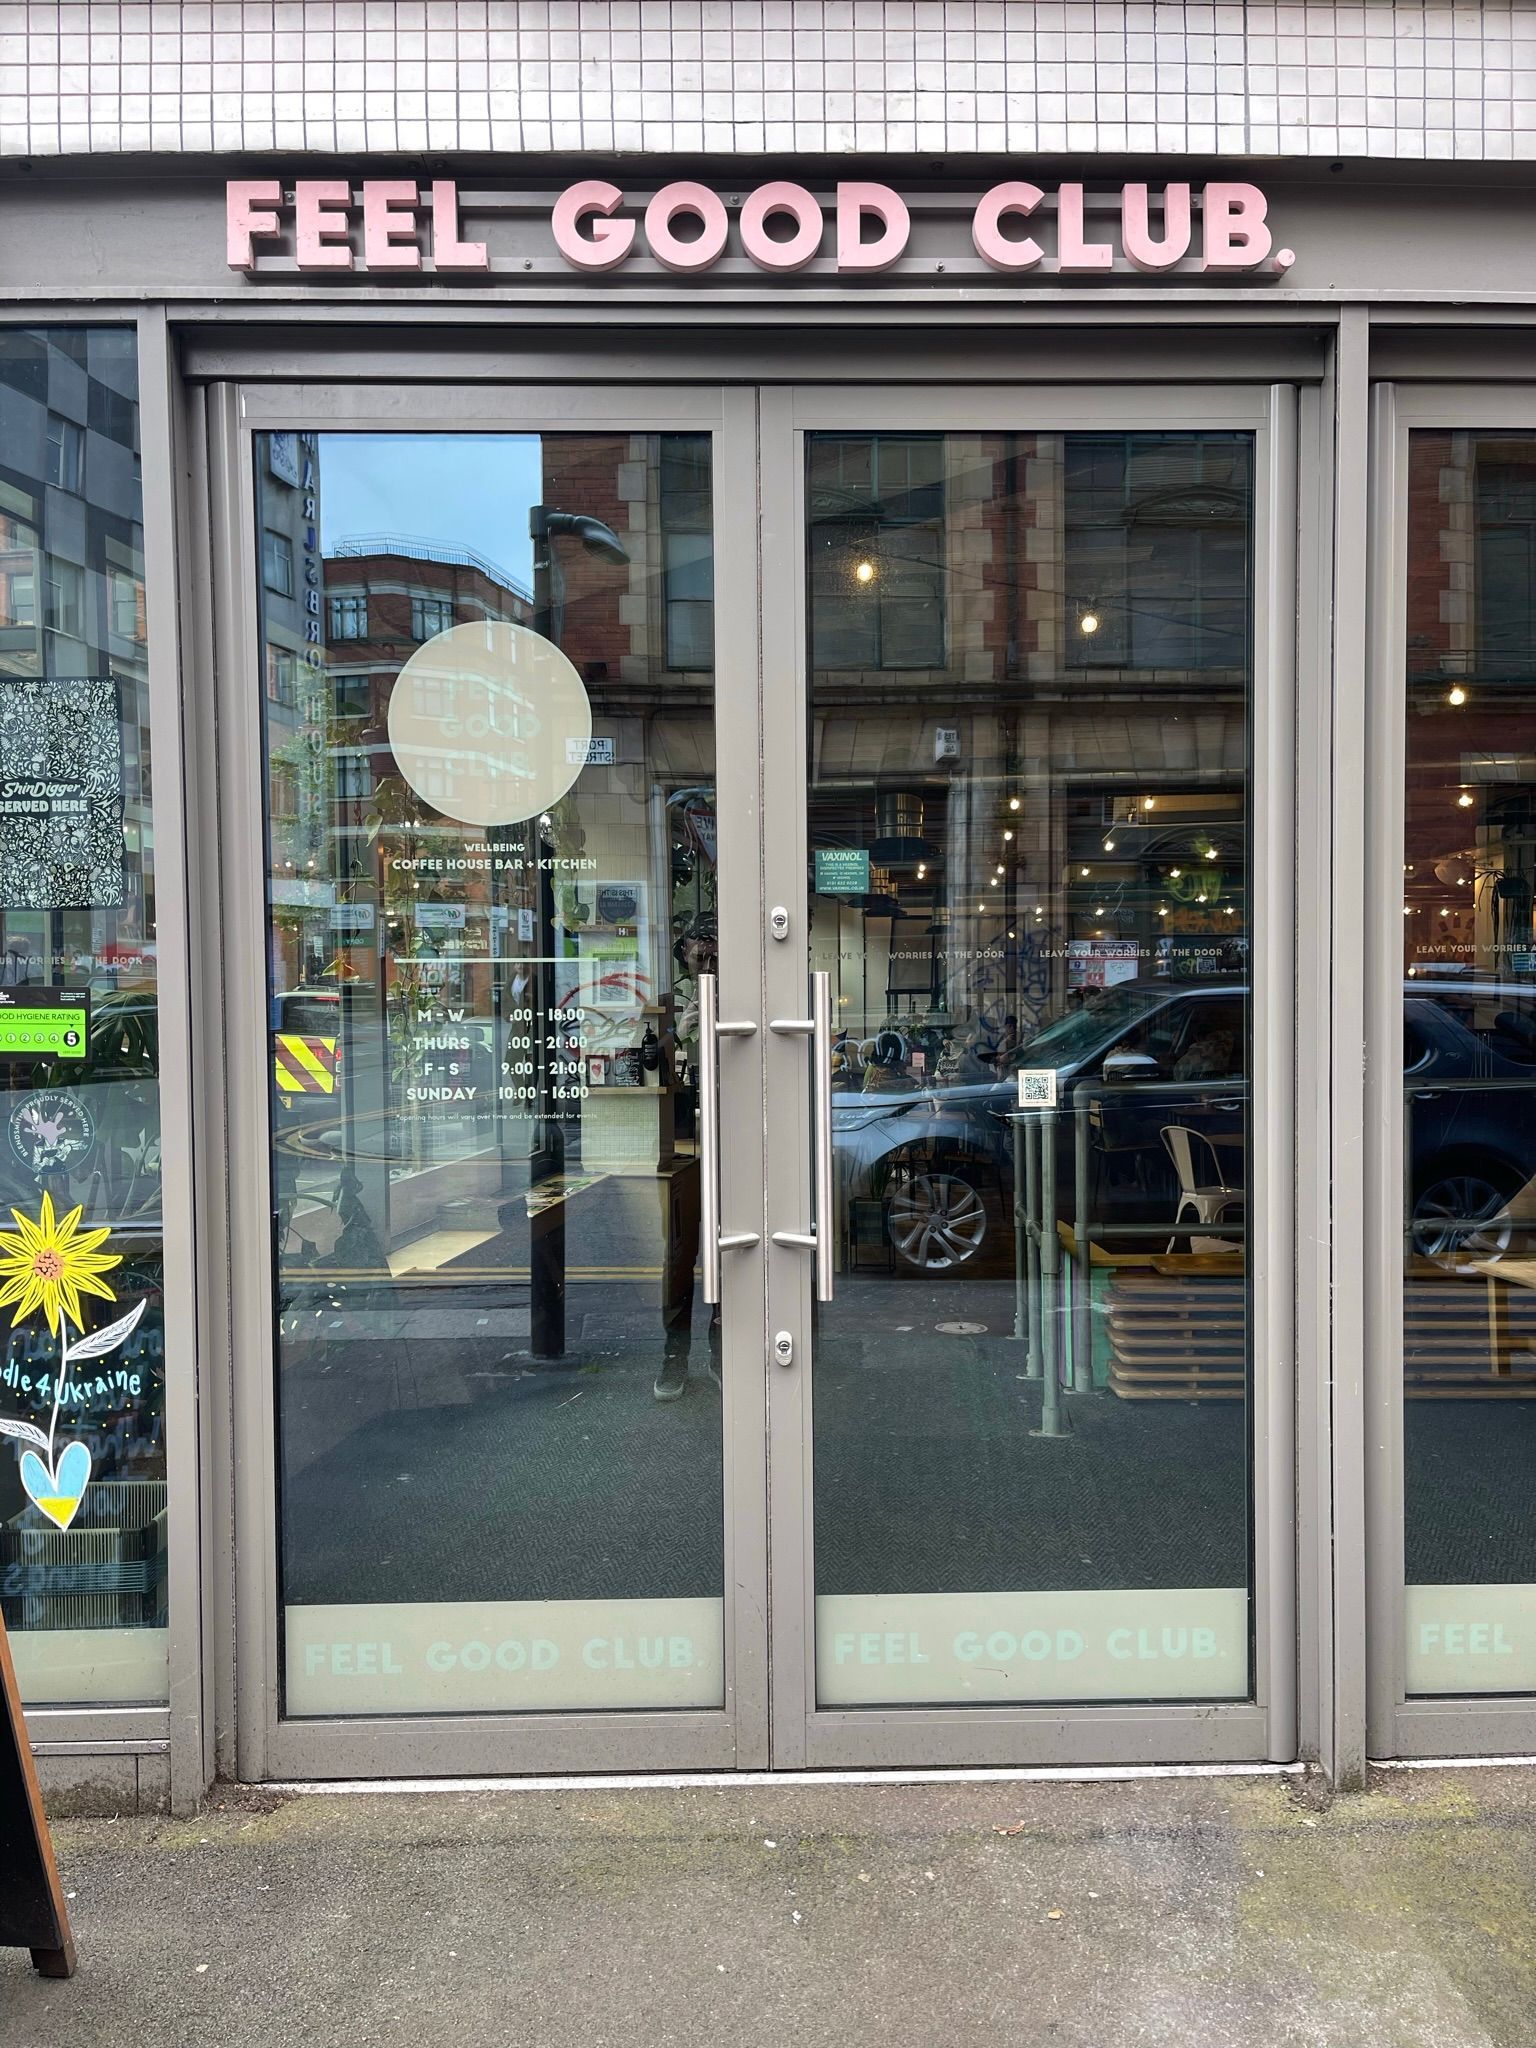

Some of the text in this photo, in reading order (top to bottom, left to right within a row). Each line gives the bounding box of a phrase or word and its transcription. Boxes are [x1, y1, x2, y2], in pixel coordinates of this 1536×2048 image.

[226, 180, 1296, 280] FEEL GOOD CLUB.
[440, 712, 541, 738] GOOD
[1, 782, 80, 798] ShinDigger
[0, 800, 88, 813] SERVED HERE
[464, 843, 525, 852] WELLBEING
[822, 852, 862, 861] VAXINOL
[392, 859, 442, 870] COFFEE
[446, 859, 491, 870] HOUSE
[495, 859, 524, 870] BAR
[538, 858, 597, 869] KITCHEN
[1040, 950, 1070, 958] LEAVE
[1105, 949, 1150, 957] WORRIES
[1172, 949, 1190, 957] THE
[1417, 945, 1446, 953] LEAVE
[1482, 944, 1526, 952] WORRIES
[17, 957, 65, 965] WORIES
[113, 957, 143, 965] DOOR
[888, 952, 933, 960] WORRIES
[954, 951, 972, 959] THE
[418, 1009, 432, 1022] M
[448, 1009, 464, 1022] W
[549, 1008, 585, 1021] 18:00
[67, 1033, 77, 1045] 5
[413, 1037, 470, 1050] THURS
[425, 1063, 432, 1075] F
[450, 1063, 459, 1075] S
[501, 1062, 534, 1075] 9:00
[549, 1062, 587, 1075] 21:00
[407, 1087, 477, 1100] SUNDAY
[499, 1087, 536, 1100] 10:00
[552, 1086, 589, 1099] 16:00
[25, 1095, 59, 1110] PROUDLY
[60, 1097, 84, 1117] SERVED
[81, 1118, 89, 1137] HERE
[493, 1112, 507, 1120] time
[0, 1358, 32, 1392] dle
[35, 1374, 51, 1397] 4
[54, 1370, 141, 1405] Ukraine
[1420, 1623, 1513, 1655] FEEL
[833, 1627, 1228, 1665] FEEL GOOD CLUB.
[305, 1636, 705, 1675] FEEL GOOD CLUB.
